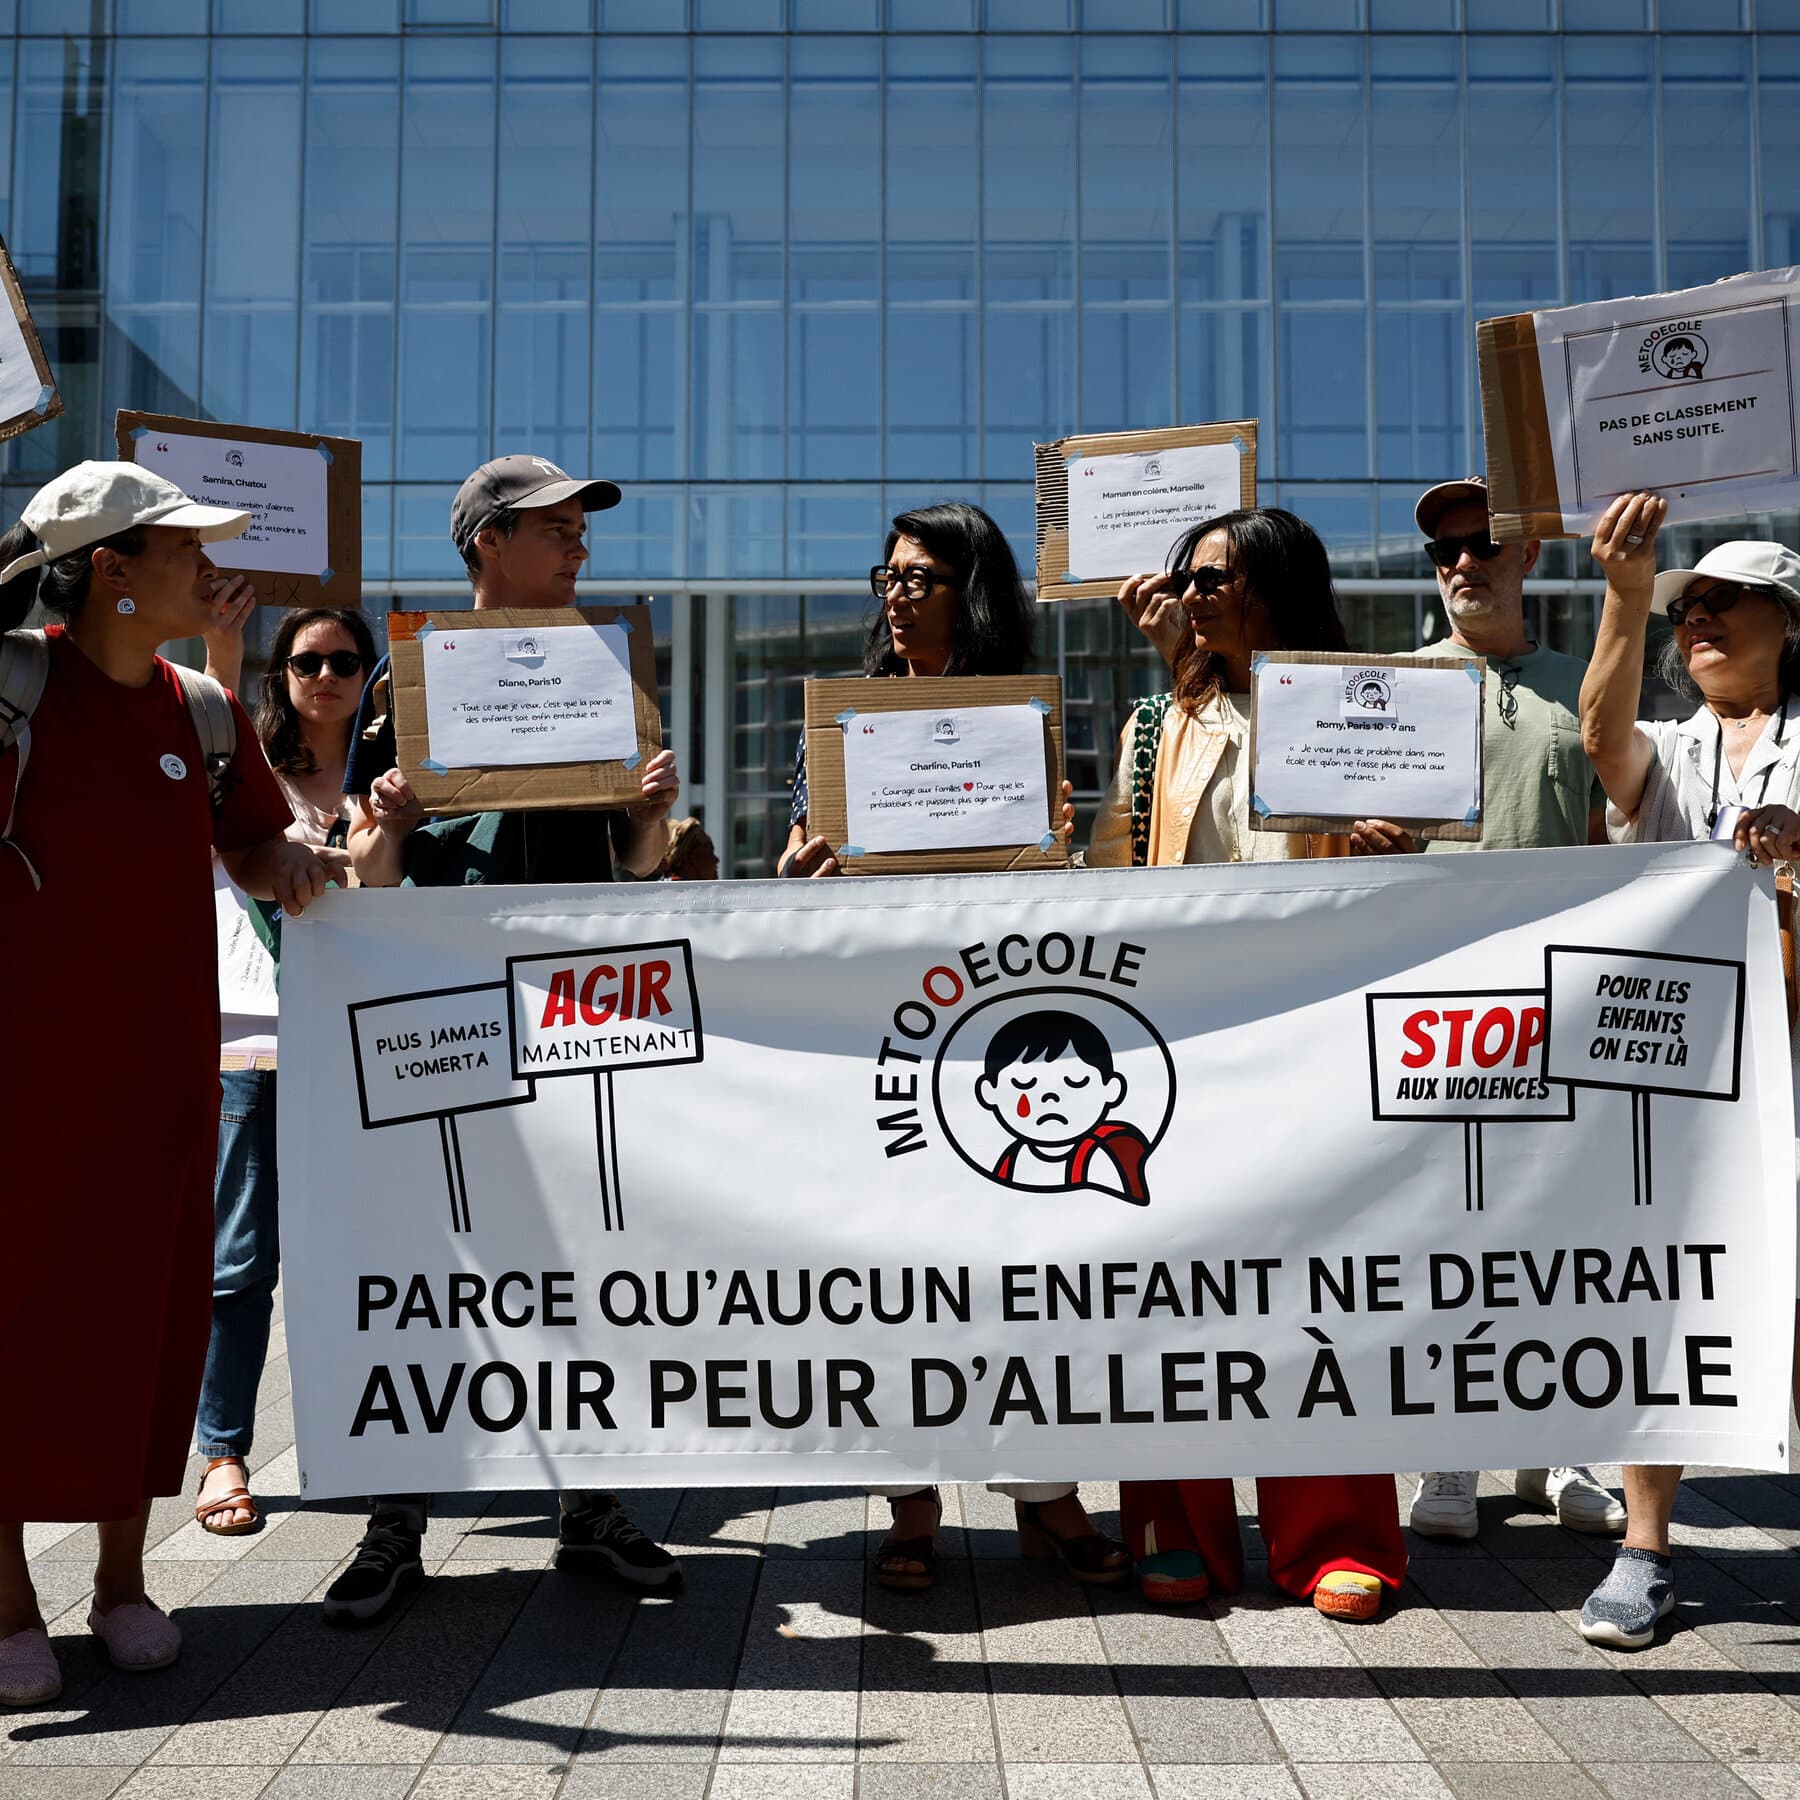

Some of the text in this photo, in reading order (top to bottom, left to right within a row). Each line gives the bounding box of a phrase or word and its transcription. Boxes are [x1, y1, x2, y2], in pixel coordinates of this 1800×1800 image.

[1638, 320, 1702, 373] METOOECOLE
[1600, 396, 1757, 432] PAS DE CLASSEMENT
[1633, 423, 1724, 446] SANS SUITE.
[202, 476, 266, 488] Samira, Chatou
[1103, 490, 1131, 499] Maman
[1170, 483, 1204, 493] Marseille
[202, 496, 230, 506] Macron
[498, 678, 528, 688] Diane,
[528, 678, 550, 686] Paris
[1345, 670, 1388, 703] METOOECOLE
[461, 702, 480, 712] Tout
[494, 704, 508, 712] que
[511, 702, 518, 712] je
[544, 700, 560, 708] c'est
[590, 698, 612, 708] parole
[466, 716, 479, 724] des
[482, 714, 512, 722] enfants
[515, 714, 528, 722] soit
[532, 712, 550, 721] enfin
[553, 711, 587, 719] entendue
[512, 723, 548, 735] respectée
[1317, 720, 1346, 731] Romy,
[1348, 721, 1370, 730] Paris
[1301, 744, 1312, 753] Je
[1336, 746, 1351, 755] plus
[1366, 746, 1403, 757] problème
[1405, 749, 1424, 757] dans
[910, 761, 950, 771] Charline,
[951, 760, 973, 768] Paris
[1286, 756, 1305, 765] école
[1320, 758, 1341, 768] qu'on
[1356, 760, 1379, 769] fasse
[1382, 761, 1396, 770] plus
[1400, 761, 1409, 770] de
[882, 787, 915, 797] Courage
[976, 782, 996, 790] Pour
[998, 783, 1013, 791] que
[870, 798, 912, 810] prédateurs
[926, 798, 955, 807] puissent
[958, 796, 972, 806] plus
[974, 796, 988, 804] agir
[929, 807, 959, 818] impunité
[540, 960, 673, 1030] AGIR
[1595, 974, 1691, 1004] POUR LES
[1597, 1006, 1685, 1034] ENFANTS
[376, 1021, 502, 1055] PLUS JAMAIS
[522, 1029, 693, 1064] MAINTENANT
[875, 931, 1146, 1158] METOOECOLE
[1400, 1006, 1545, 1068] STOP
[1589, 1035, 1688, 1067] ON EST LÀ
[395, 1051, 488, 1080] L'OMERTA
[1397, 1076, 1550, 1100] AUX VIOLENCES
[357, 1244, 1726, 1332] PARCE QU'AUCUN ENFANT NE DEVRAIT
[349, 1320, 1738, 1436] AVOIR PEUR D'ALLER À L'ÉCOLE
